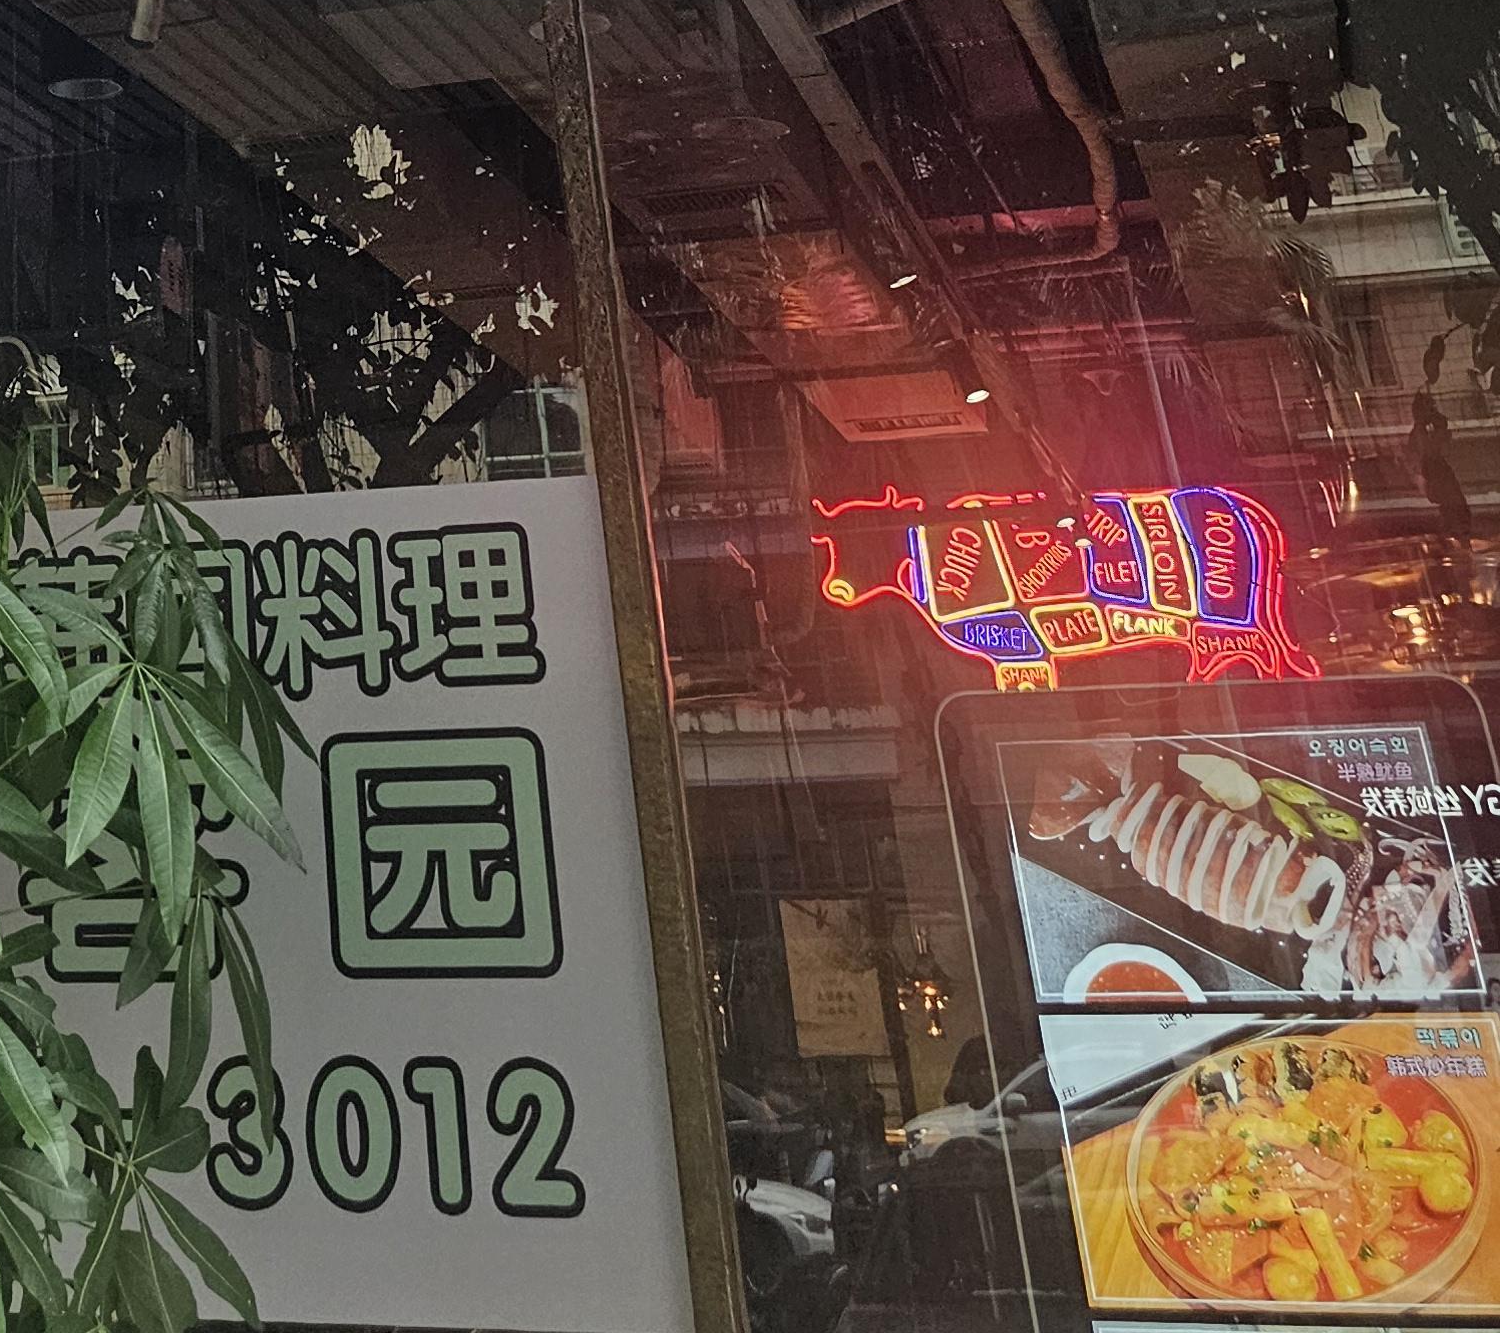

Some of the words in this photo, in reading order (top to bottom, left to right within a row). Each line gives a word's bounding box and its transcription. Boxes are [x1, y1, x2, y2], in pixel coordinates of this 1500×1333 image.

[936, 527, 982, 602] CHUCK
[1141, 503, 1182, 601] SIRLOIN
[1203, 510, 1236, 599] ROUND
[1093, 560, 1140, 586] FILET
[964, 621, 1028, 652] BRISKET
[1042, 609, 1100, 645] PLATE
[1112, 609, 1178, 637] FLANK
[1195, 633, 1266, 655] SHANK
[1001, 666, 1048, 684] SHANK
[207, 1055, 586, 1218] 3012
